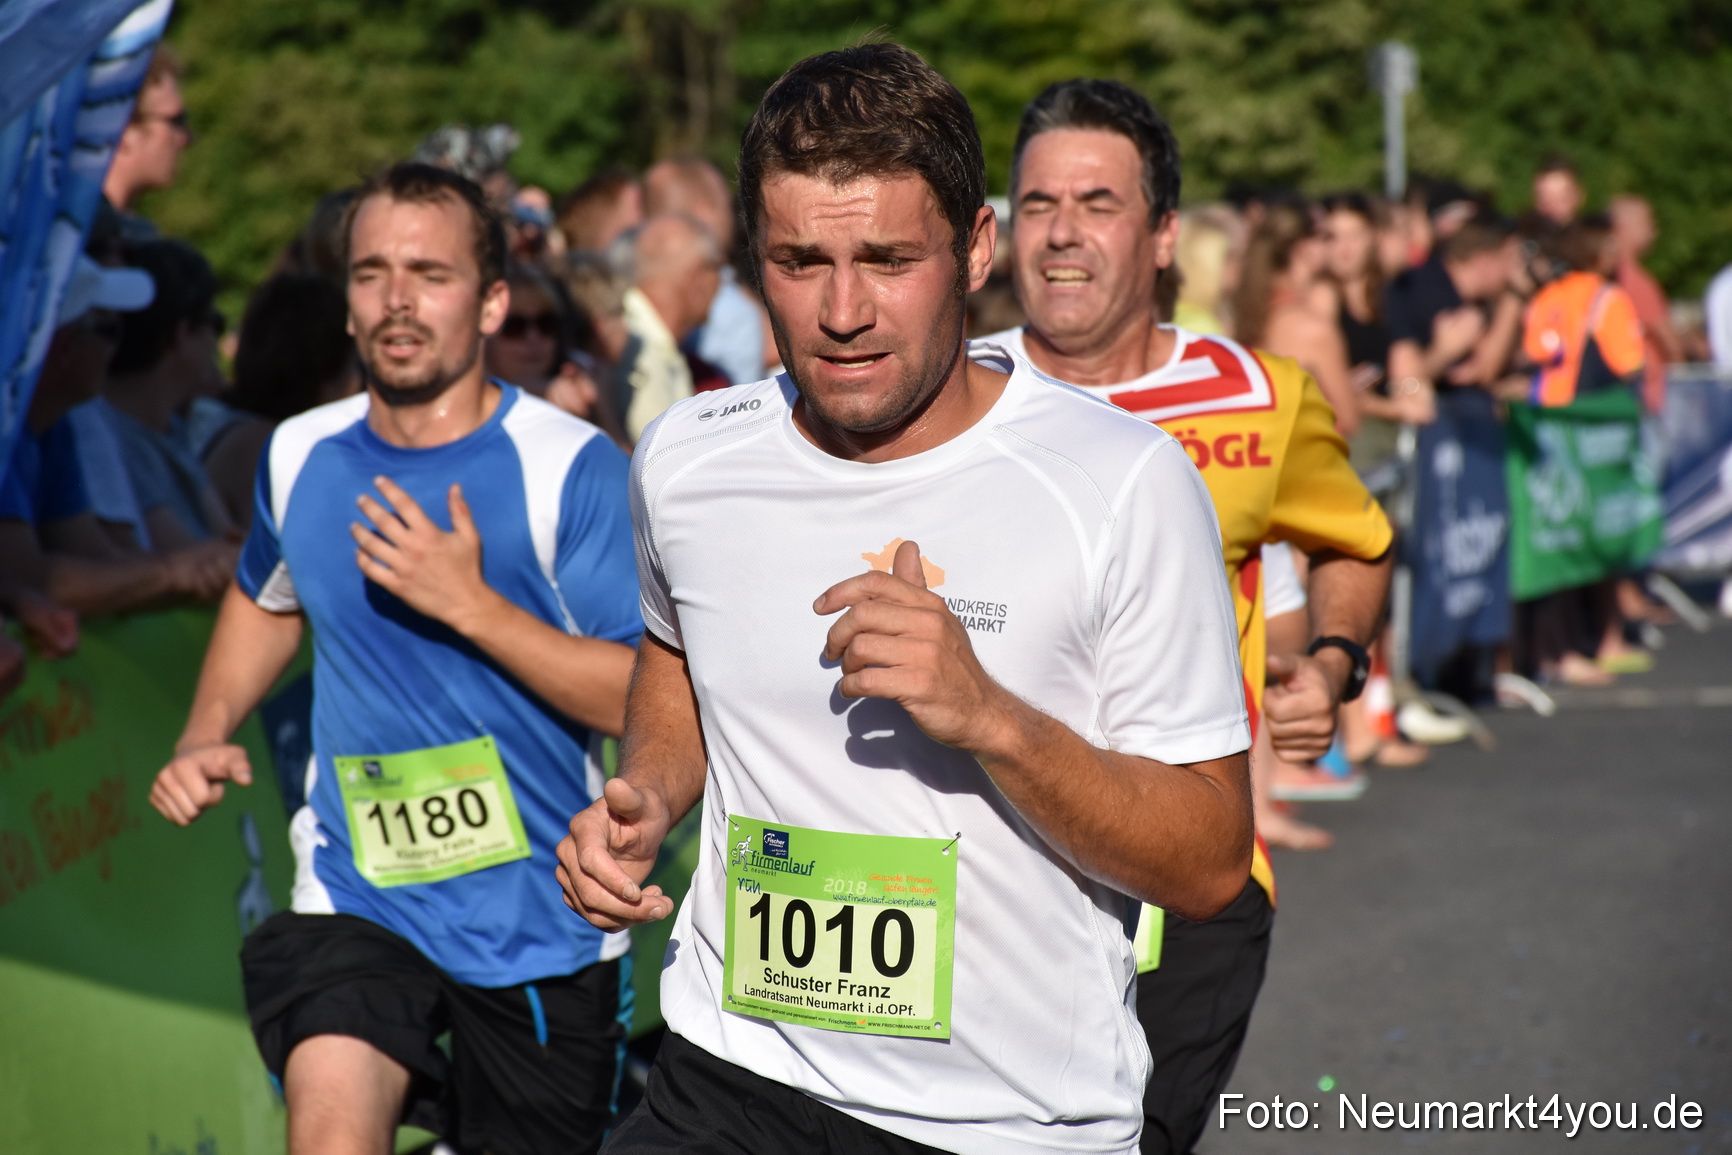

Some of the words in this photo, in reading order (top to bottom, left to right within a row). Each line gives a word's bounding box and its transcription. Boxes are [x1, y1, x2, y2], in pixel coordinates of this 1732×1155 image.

[719, 399, 762, 417] JAKO
[1174, 429, 1271, 469] ÖGL
[942, 597, 1008, 618] NDKREIS
[957, 614, 1006, 633] MARKT
[367, 787, 489, 846] 1180
[751, 850, 816, 876] firmenlauf
[751, 867, 777, 877] neumarkt
[823, 877, 867, 895] 2018
[749, 893, 915, 978] 1010
[763, 967, 832, 994] Schuster
[837, 979, 891, 999] Franz
[744, 984, 803, 1006] Landratsamt
[806, 996, 864, 1013] Neumarkt
[868, 1002, 916, 1016] i.d.OPf.
[828, 1018, 857, 1026] Frischmann
